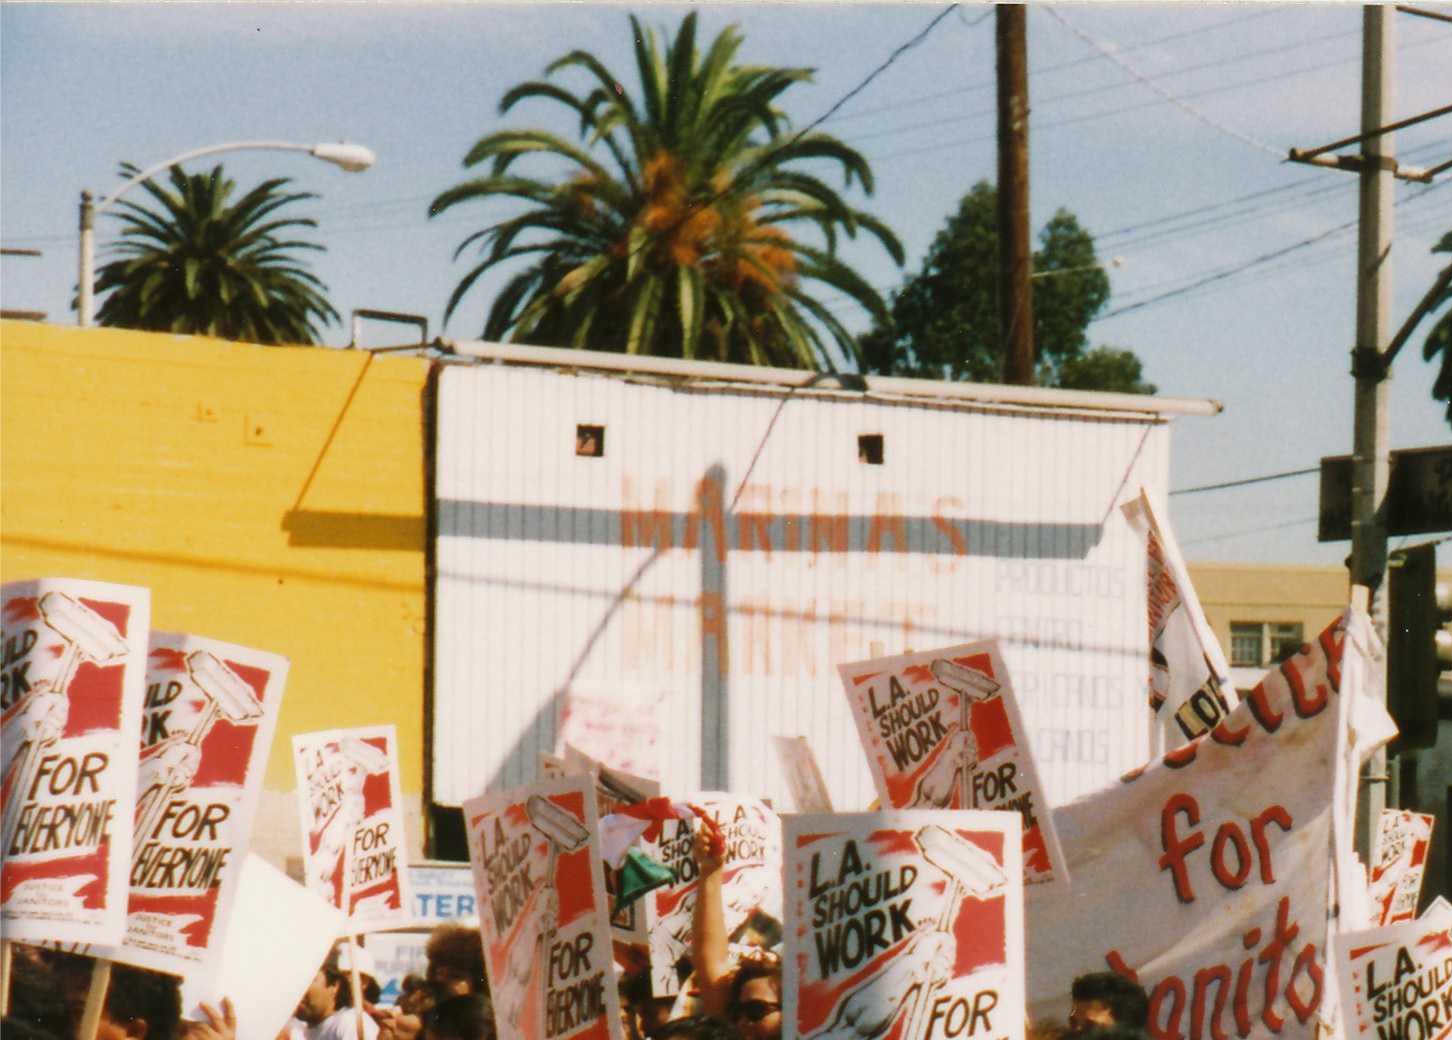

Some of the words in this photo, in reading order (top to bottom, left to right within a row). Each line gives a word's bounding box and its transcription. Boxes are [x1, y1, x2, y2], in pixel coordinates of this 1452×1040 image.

[868, 674, 911, 719] L.A.
[879, 687, 940, 739] SHOULD
[886, 710, 948, 772] WORK
[27, 751, 109, 801] FOR
[972, 762, 1018, 803] FOR
[12, 799, 117, 857] EVERYONE
[150, 800, 231, 841] FOR
[353, 822, 390, 854] FOR
[129, 842, 232, 889] EVERYONE
[661, 838, 695, 863] SHO
[808, 838, 872, 900] L.A.
[1159, 792, 1293, 903] for
[812, 865, 918, 928] SHOULD
[550, 932, 593, 980] FOR
[1365, 945, 1423, 998] L.A.
